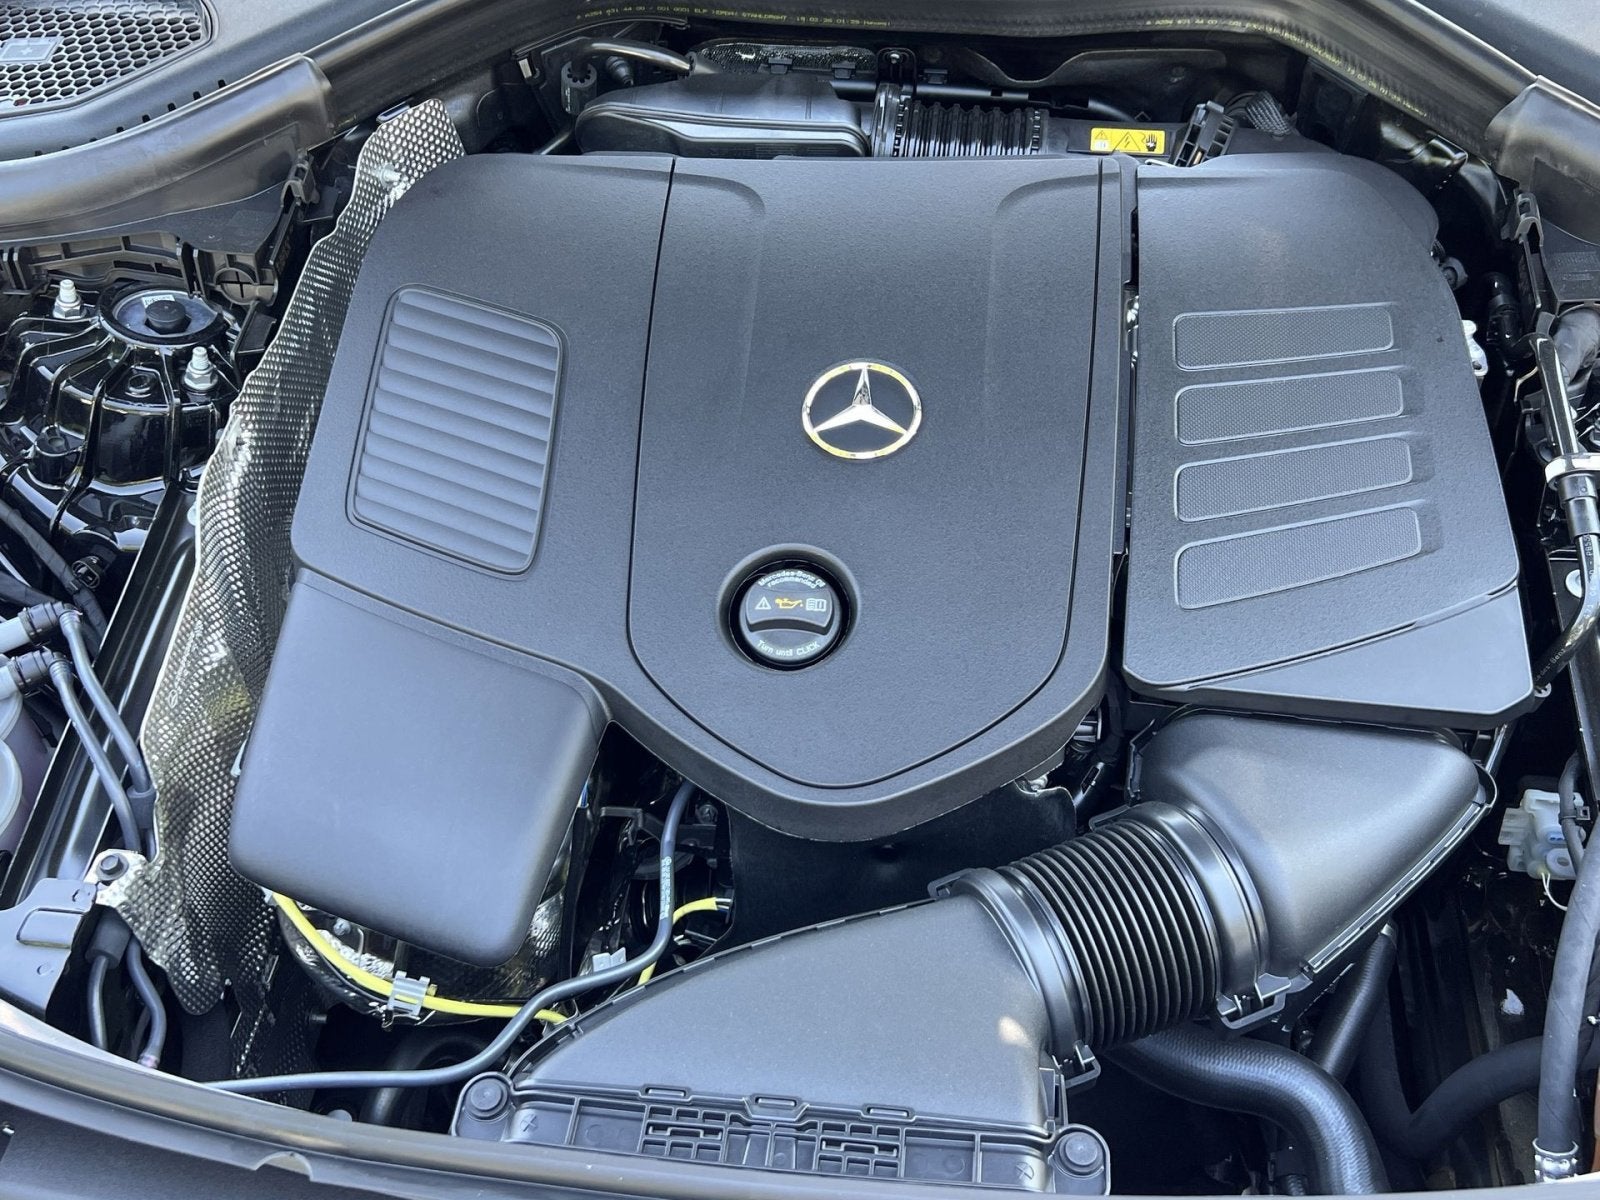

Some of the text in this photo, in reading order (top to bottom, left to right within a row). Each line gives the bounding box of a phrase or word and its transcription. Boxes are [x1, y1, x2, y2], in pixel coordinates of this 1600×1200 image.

[758, 570, 816, 586] Mercedes-Benz
[757, 640, 820, 657] Turn until CLICK
